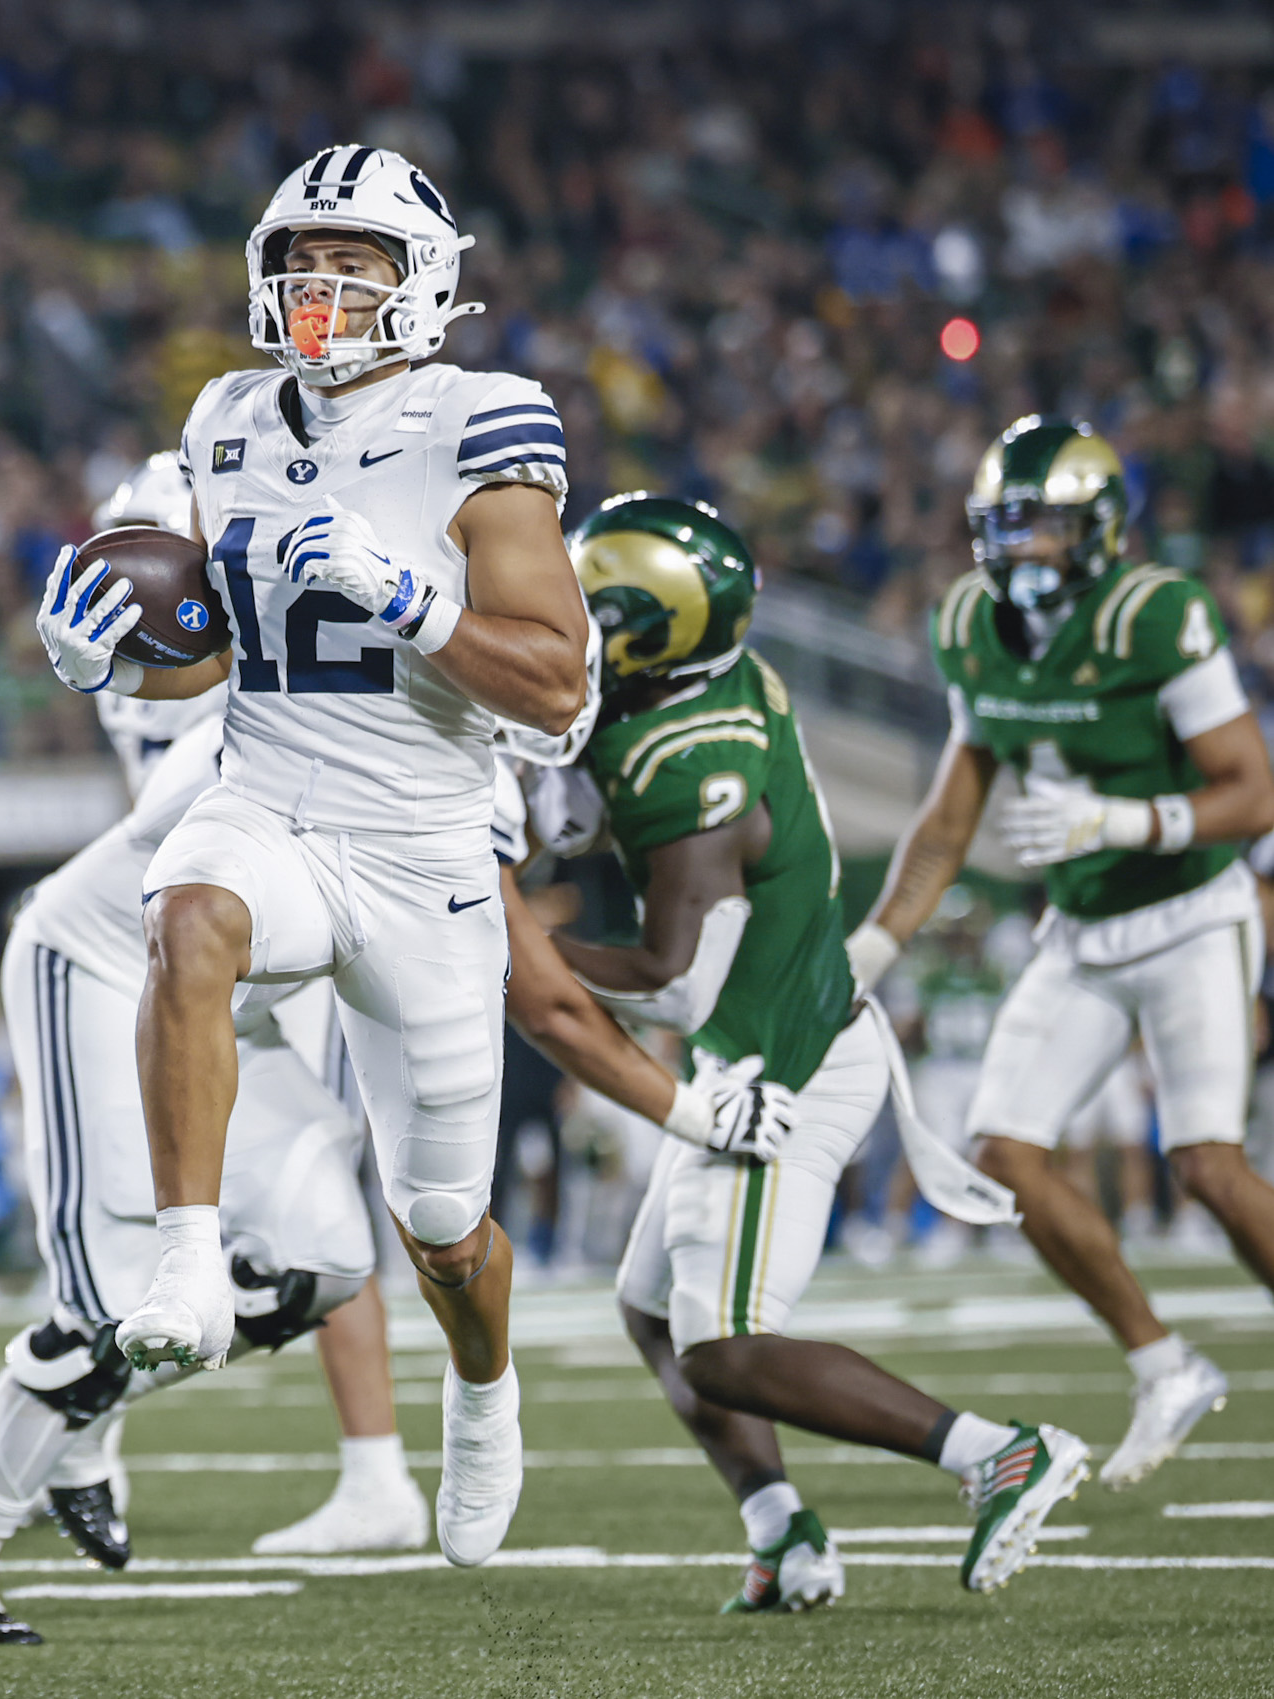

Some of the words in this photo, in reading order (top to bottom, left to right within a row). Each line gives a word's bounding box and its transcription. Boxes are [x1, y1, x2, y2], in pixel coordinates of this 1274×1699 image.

[310, 199, 338, 211] BYU
[401, 410, 433, 418] entrata
[292, 462, 313, 481] Y
[211, 517, 395, 694] 12
[698, 770, 748, 831] 2
